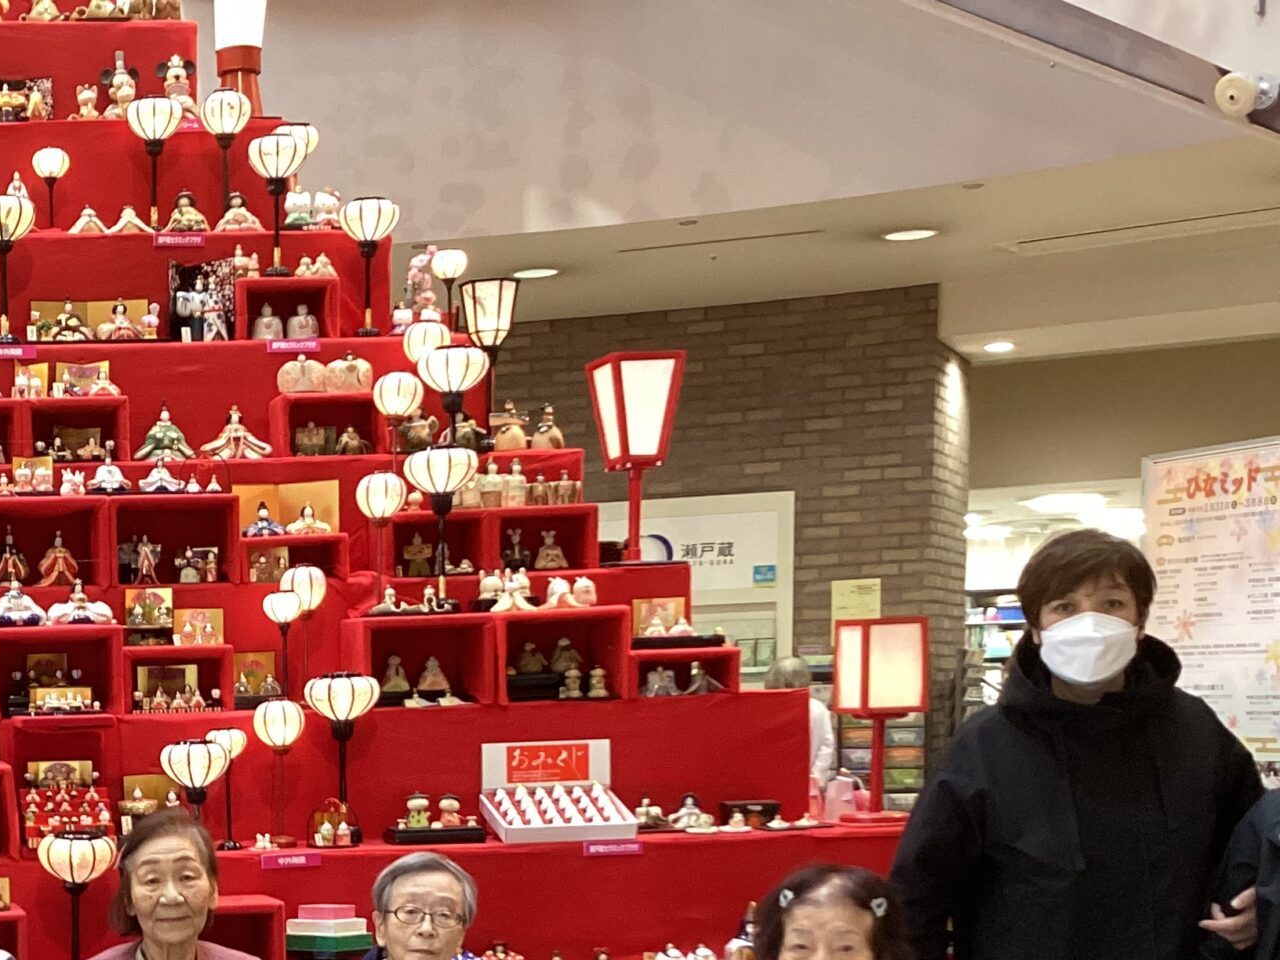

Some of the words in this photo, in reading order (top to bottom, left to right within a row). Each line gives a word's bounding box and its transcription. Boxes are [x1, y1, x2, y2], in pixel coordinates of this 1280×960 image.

[680, 542, 735, 559] 瀬戸蔵
[511, 746, 585, 770] おみくじ
